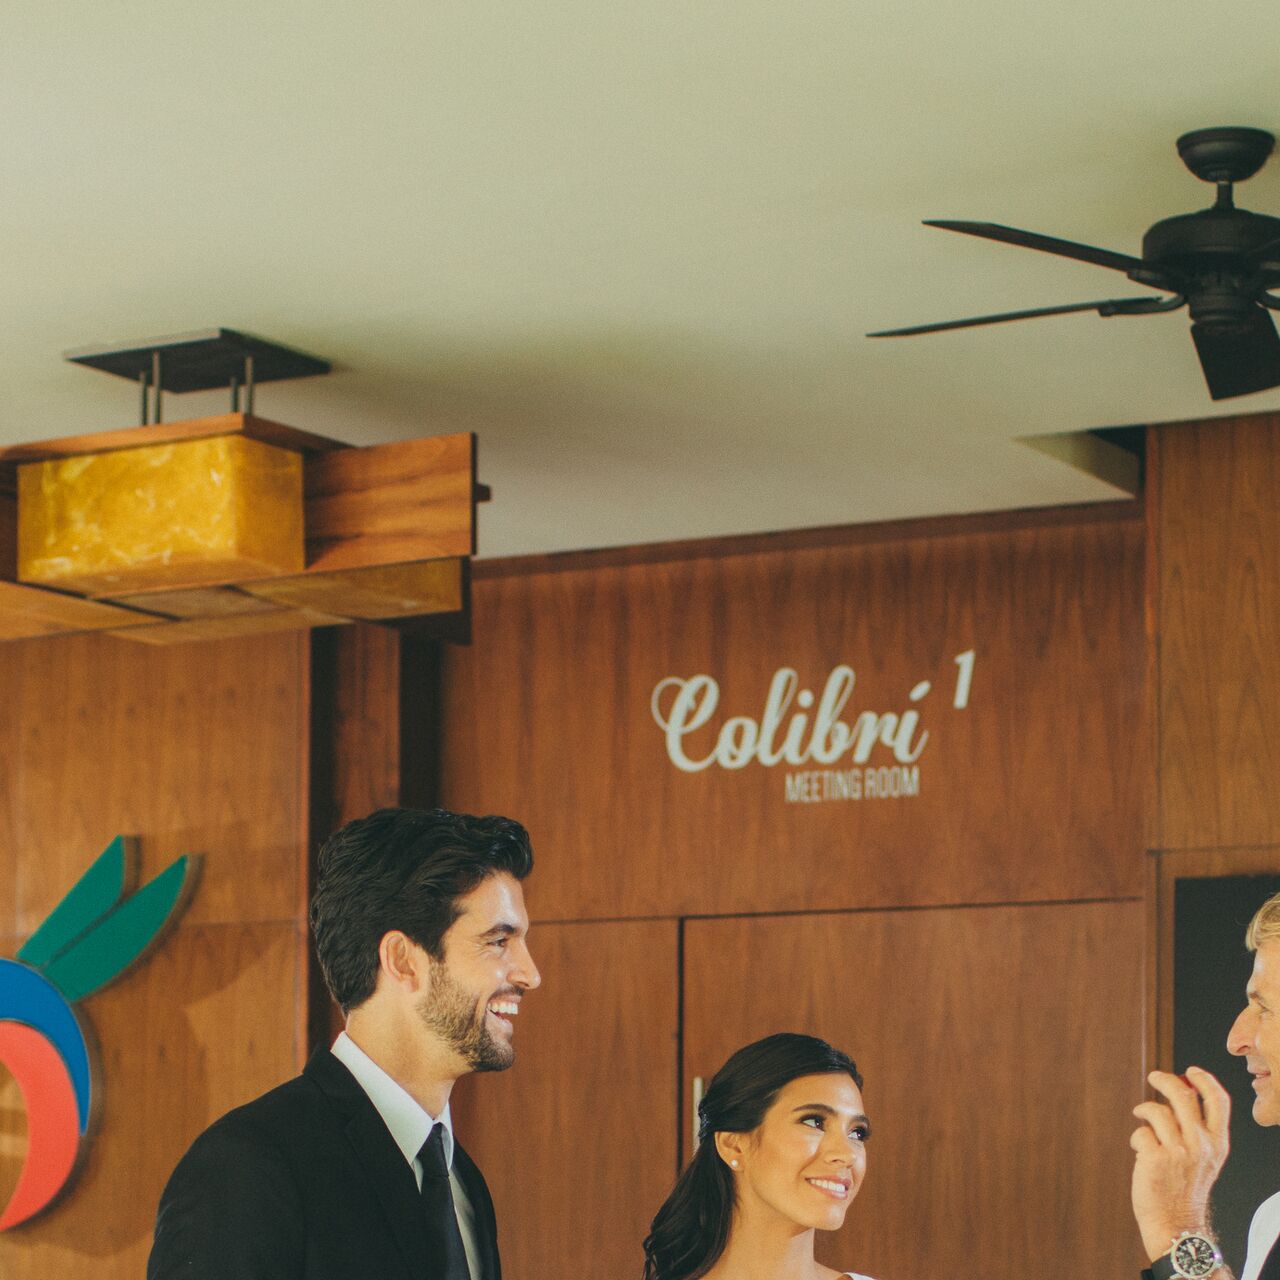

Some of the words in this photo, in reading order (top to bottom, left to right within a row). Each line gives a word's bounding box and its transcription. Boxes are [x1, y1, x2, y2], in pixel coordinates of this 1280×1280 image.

[651, 665, 931, 772] Colibrí
[953, 649, 976, 710] 1
[785, 769, 862, 803] MEETING
[864, 767, 920, 798] ROOM
